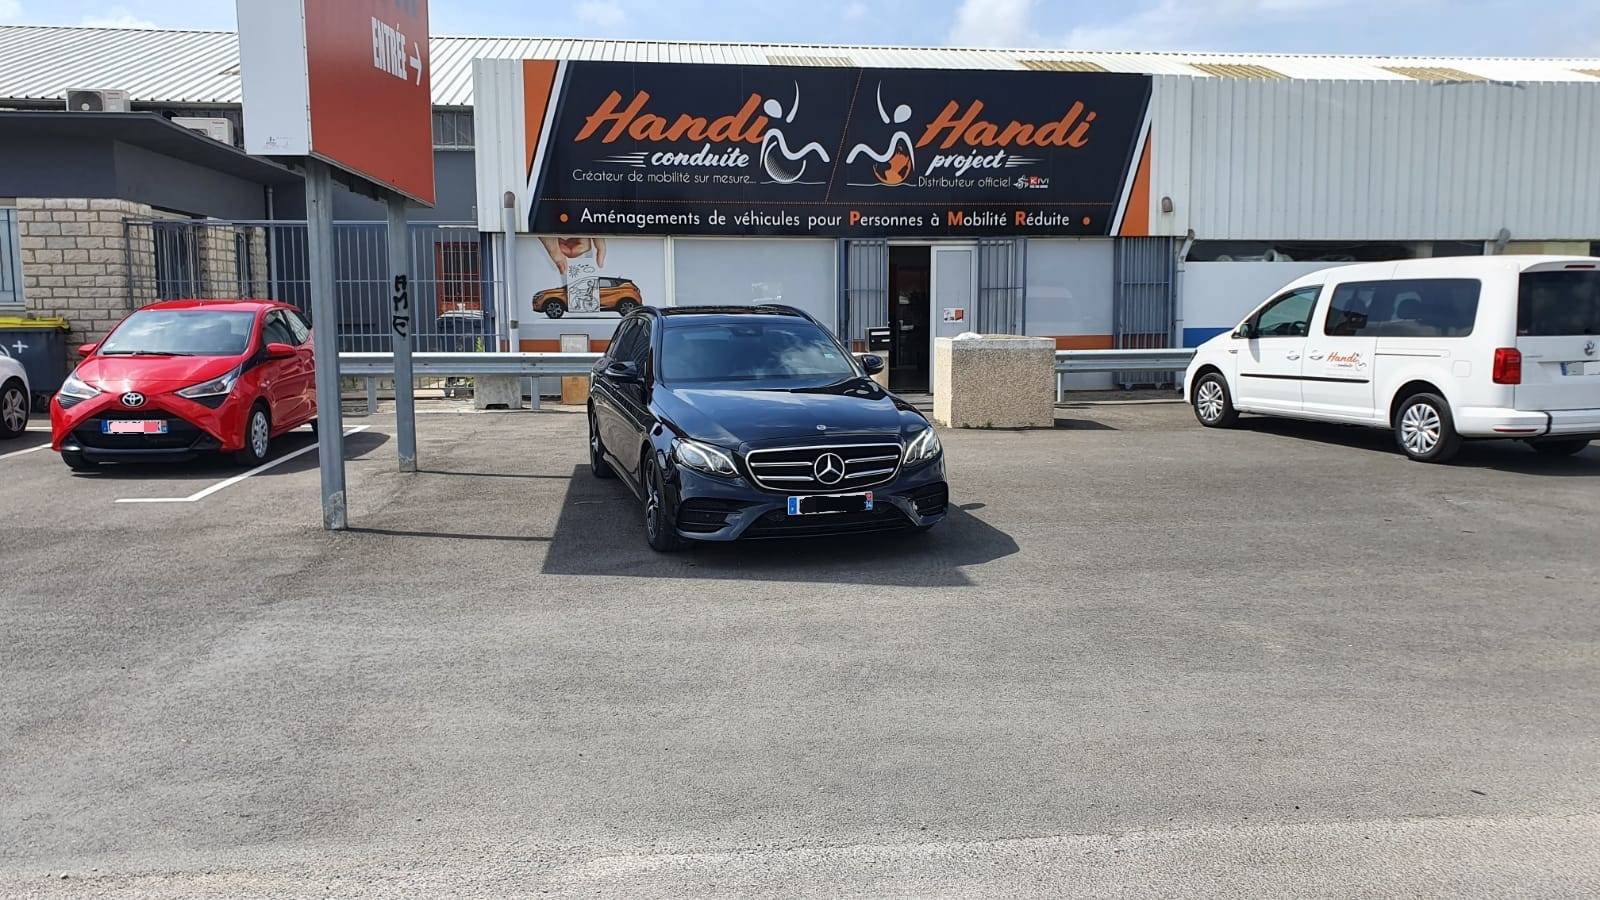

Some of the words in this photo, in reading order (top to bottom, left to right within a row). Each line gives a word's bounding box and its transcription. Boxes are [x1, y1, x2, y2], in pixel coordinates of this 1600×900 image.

[372, 16, 408, 80] ENTRÉE
[574, 90, 769, 144] Handi
[915, 99, 1097, 149] Handi
[651, 143, 750, 168] conduite
[925, 149, 1007, 177] project
[572, 169, 624, 182] Créateur
[627, 171, 644, 183] de
[647, 171, 691, 183] mobilité
[694, 174, 709, 184] sur
[918, 176, 974, 188] Distributeur
[977, 176, 1011, 188] officiel
[580, 208, 700, 229] Aménagements
[708, 210, 726, 226] de
[734, 210, 800, 226] véhicules
[808, 217, 842, 230] pour
[850, 210, 923, 227] Personnes
[930, 213, 940, 226] à
[948, 210, 1007, 227] Mobilité
[1015, 210, 1070, 227] Réduite
[1327, 352, 1360, 363] Handi
